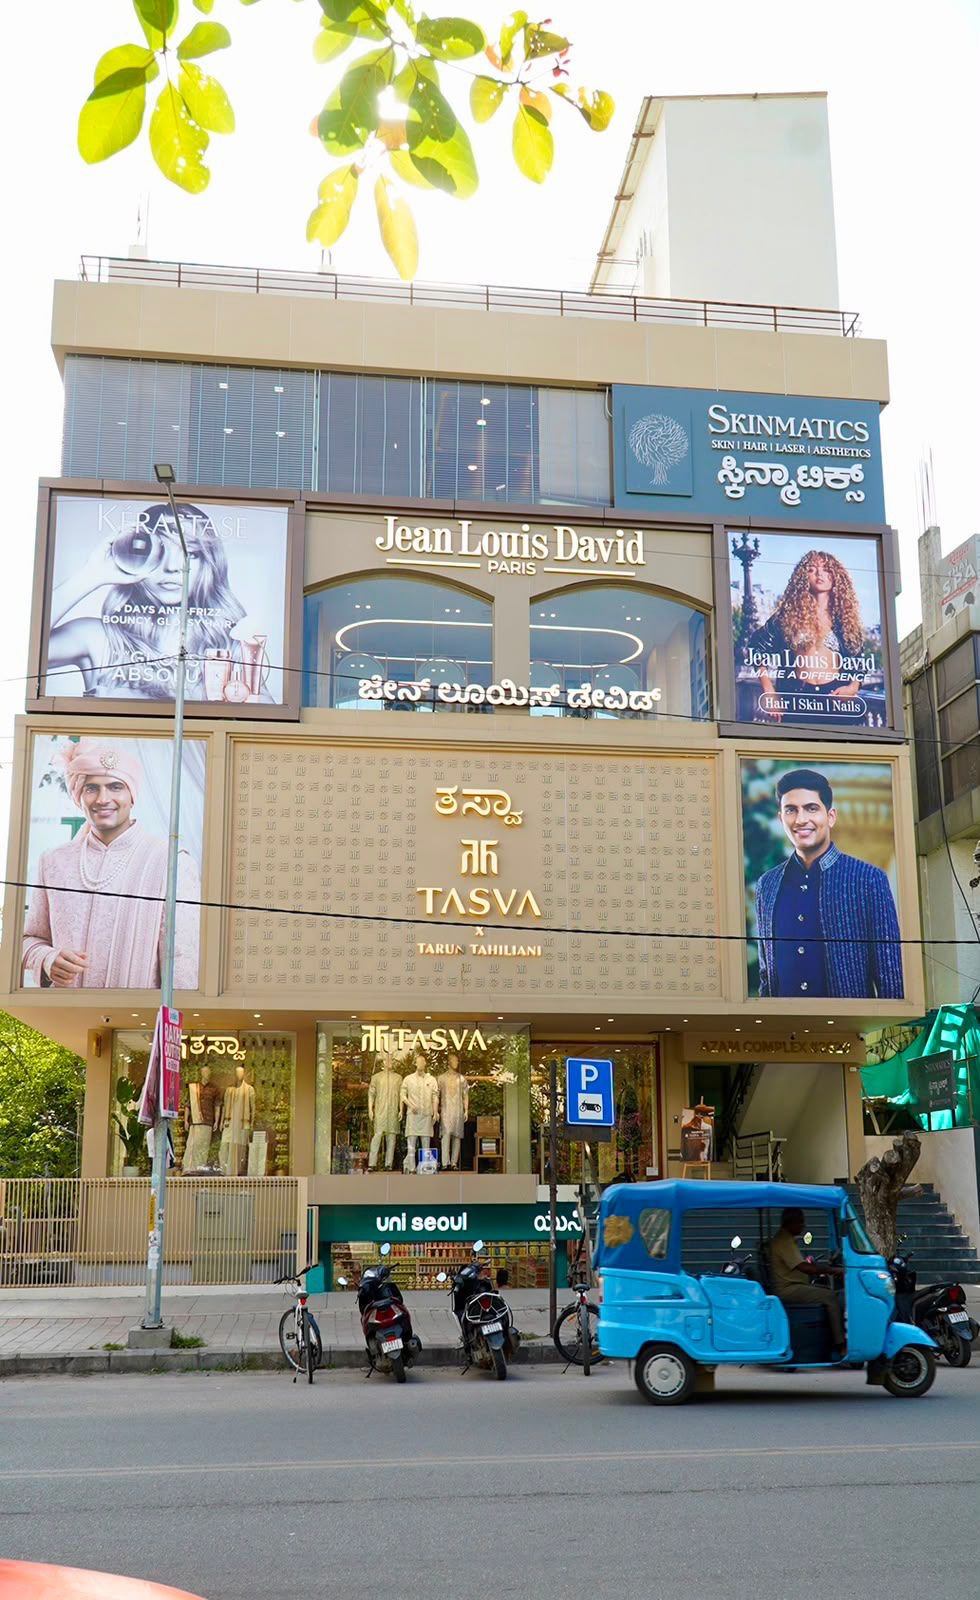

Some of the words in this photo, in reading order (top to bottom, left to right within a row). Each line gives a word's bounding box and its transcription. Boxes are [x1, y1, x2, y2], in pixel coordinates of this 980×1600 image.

[708, 404, 870, 443] SKINMATICS
[711, 439, 735, 450] SKIN
[743, 440, 768, 452] HAIR
[775, 443, 806, 454] LASER
[812, 445, 872, 458] AESTHETICS
[375, 515, 454, 554] Jean
[457, 520, 549, 560] Louis
[553, 525, 647, 565] David
[487, 560, 536, 576] PARIS
[124, 605, 156, 614] DAYS
[158, 606, 224, 617] ANT-FRIZZ
[102, 615, 154, 626] BOUNCY,
[157, 617, 201, 627] GLOSY
[743, 647, 782, 667] Jean
[784, 649, 829, 669] Louis
[831, 651, 877, 672] David
[750, 669, 786, 680] MAKE
[787, 670, 797, 680] A
[799, 671, 872, 682] DIFFERENCE
[765, 697, 790, 709] Hair
[798, 698, 824, 711] Skin
[832, 699, 861, 713] Nails
[435, 785, 524, 826] ತಸ್ವಾ
[416, 887, 542, 917] TASVA
[416, 942, 465, 955] TARUN
[469, 943, 543, 957] TAHILIANI
[190, 1034, 247, 1061] ತಸ್ವಾ
[391, 1028, 488, 1051] TASVA
[700, 1040, 740, 1053] AZAM
[743, 1040, 807, 1053] COMPLEX
[581, 1064, 599, 1091] P
[376, 1212, 406, 1231] uni
[411, 1212, 467, 1231] seoul
